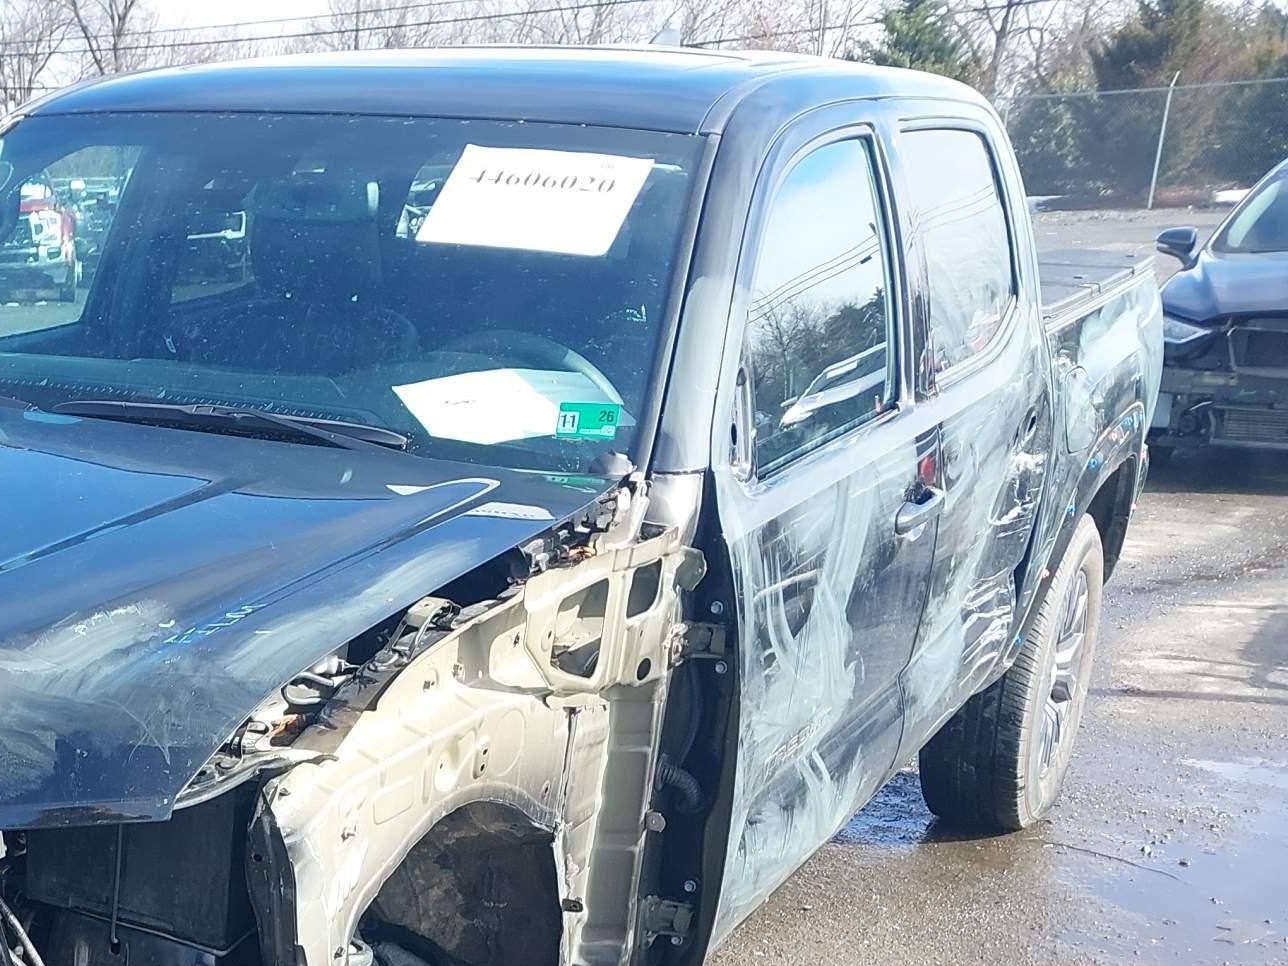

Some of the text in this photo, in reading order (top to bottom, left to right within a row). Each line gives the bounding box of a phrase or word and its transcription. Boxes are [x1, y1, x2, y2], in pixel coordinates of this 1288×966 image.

[469, 168, 616, 193] 44606020
[560, 413, 577, 428] 11
[598, 409, 616, 423] 26
